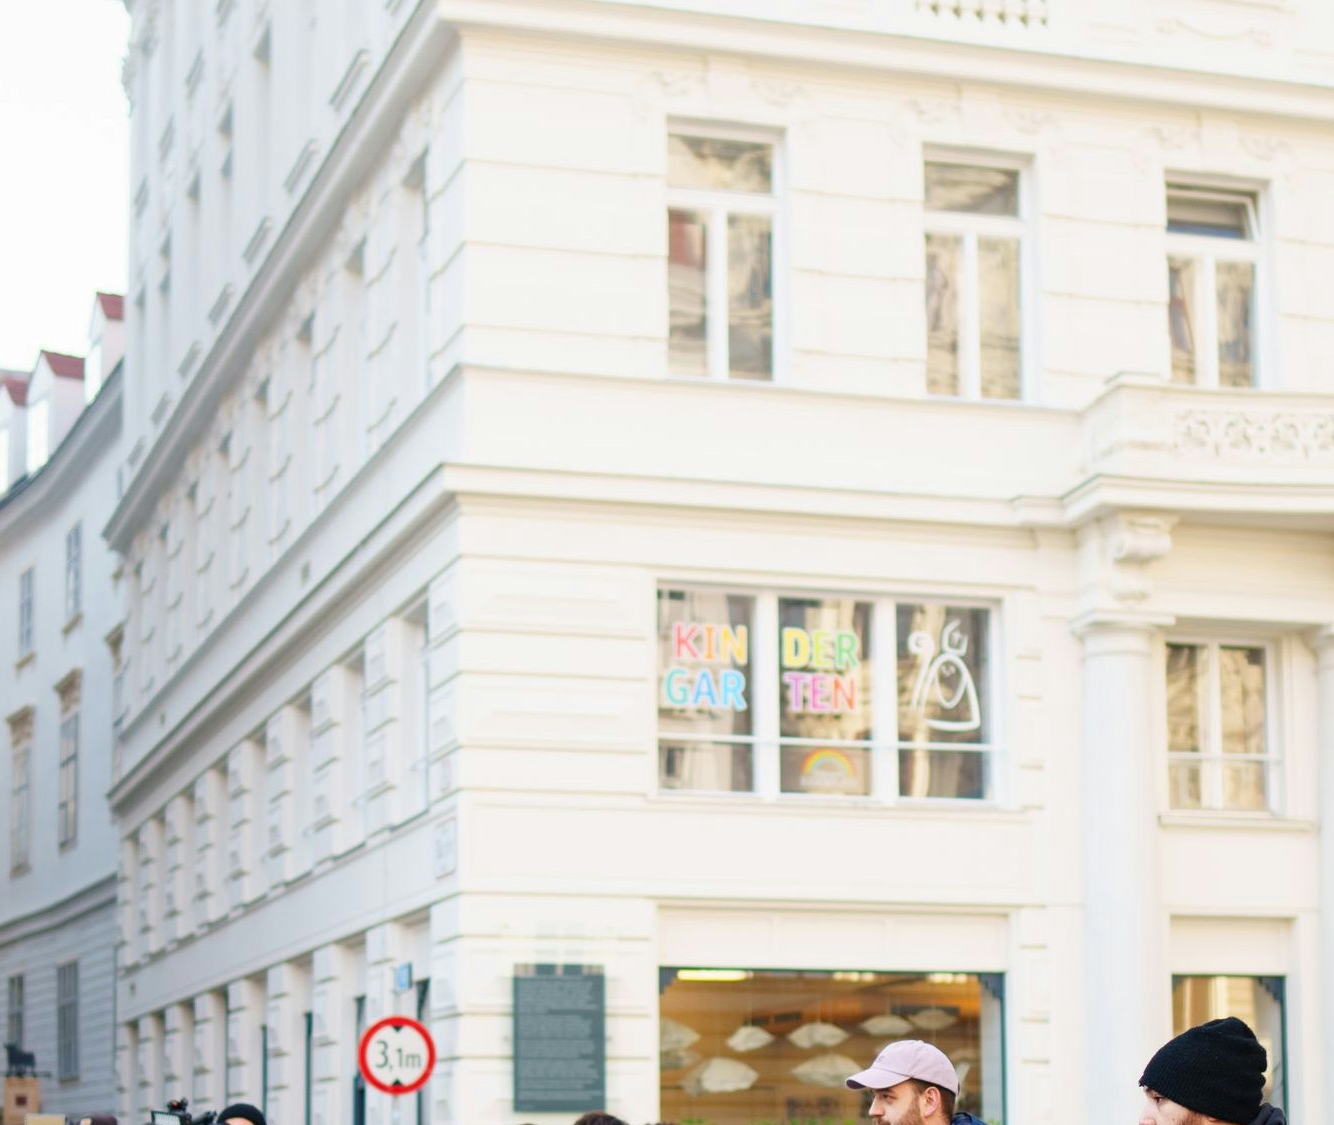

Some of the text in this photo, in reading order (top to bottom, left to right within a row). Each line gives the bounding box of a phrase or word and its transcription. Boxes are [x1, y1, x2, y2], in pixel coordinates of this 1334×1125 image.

[674, 623, 860, 669] KIN DER
[665, 668, 858, 713] GAR TEN
